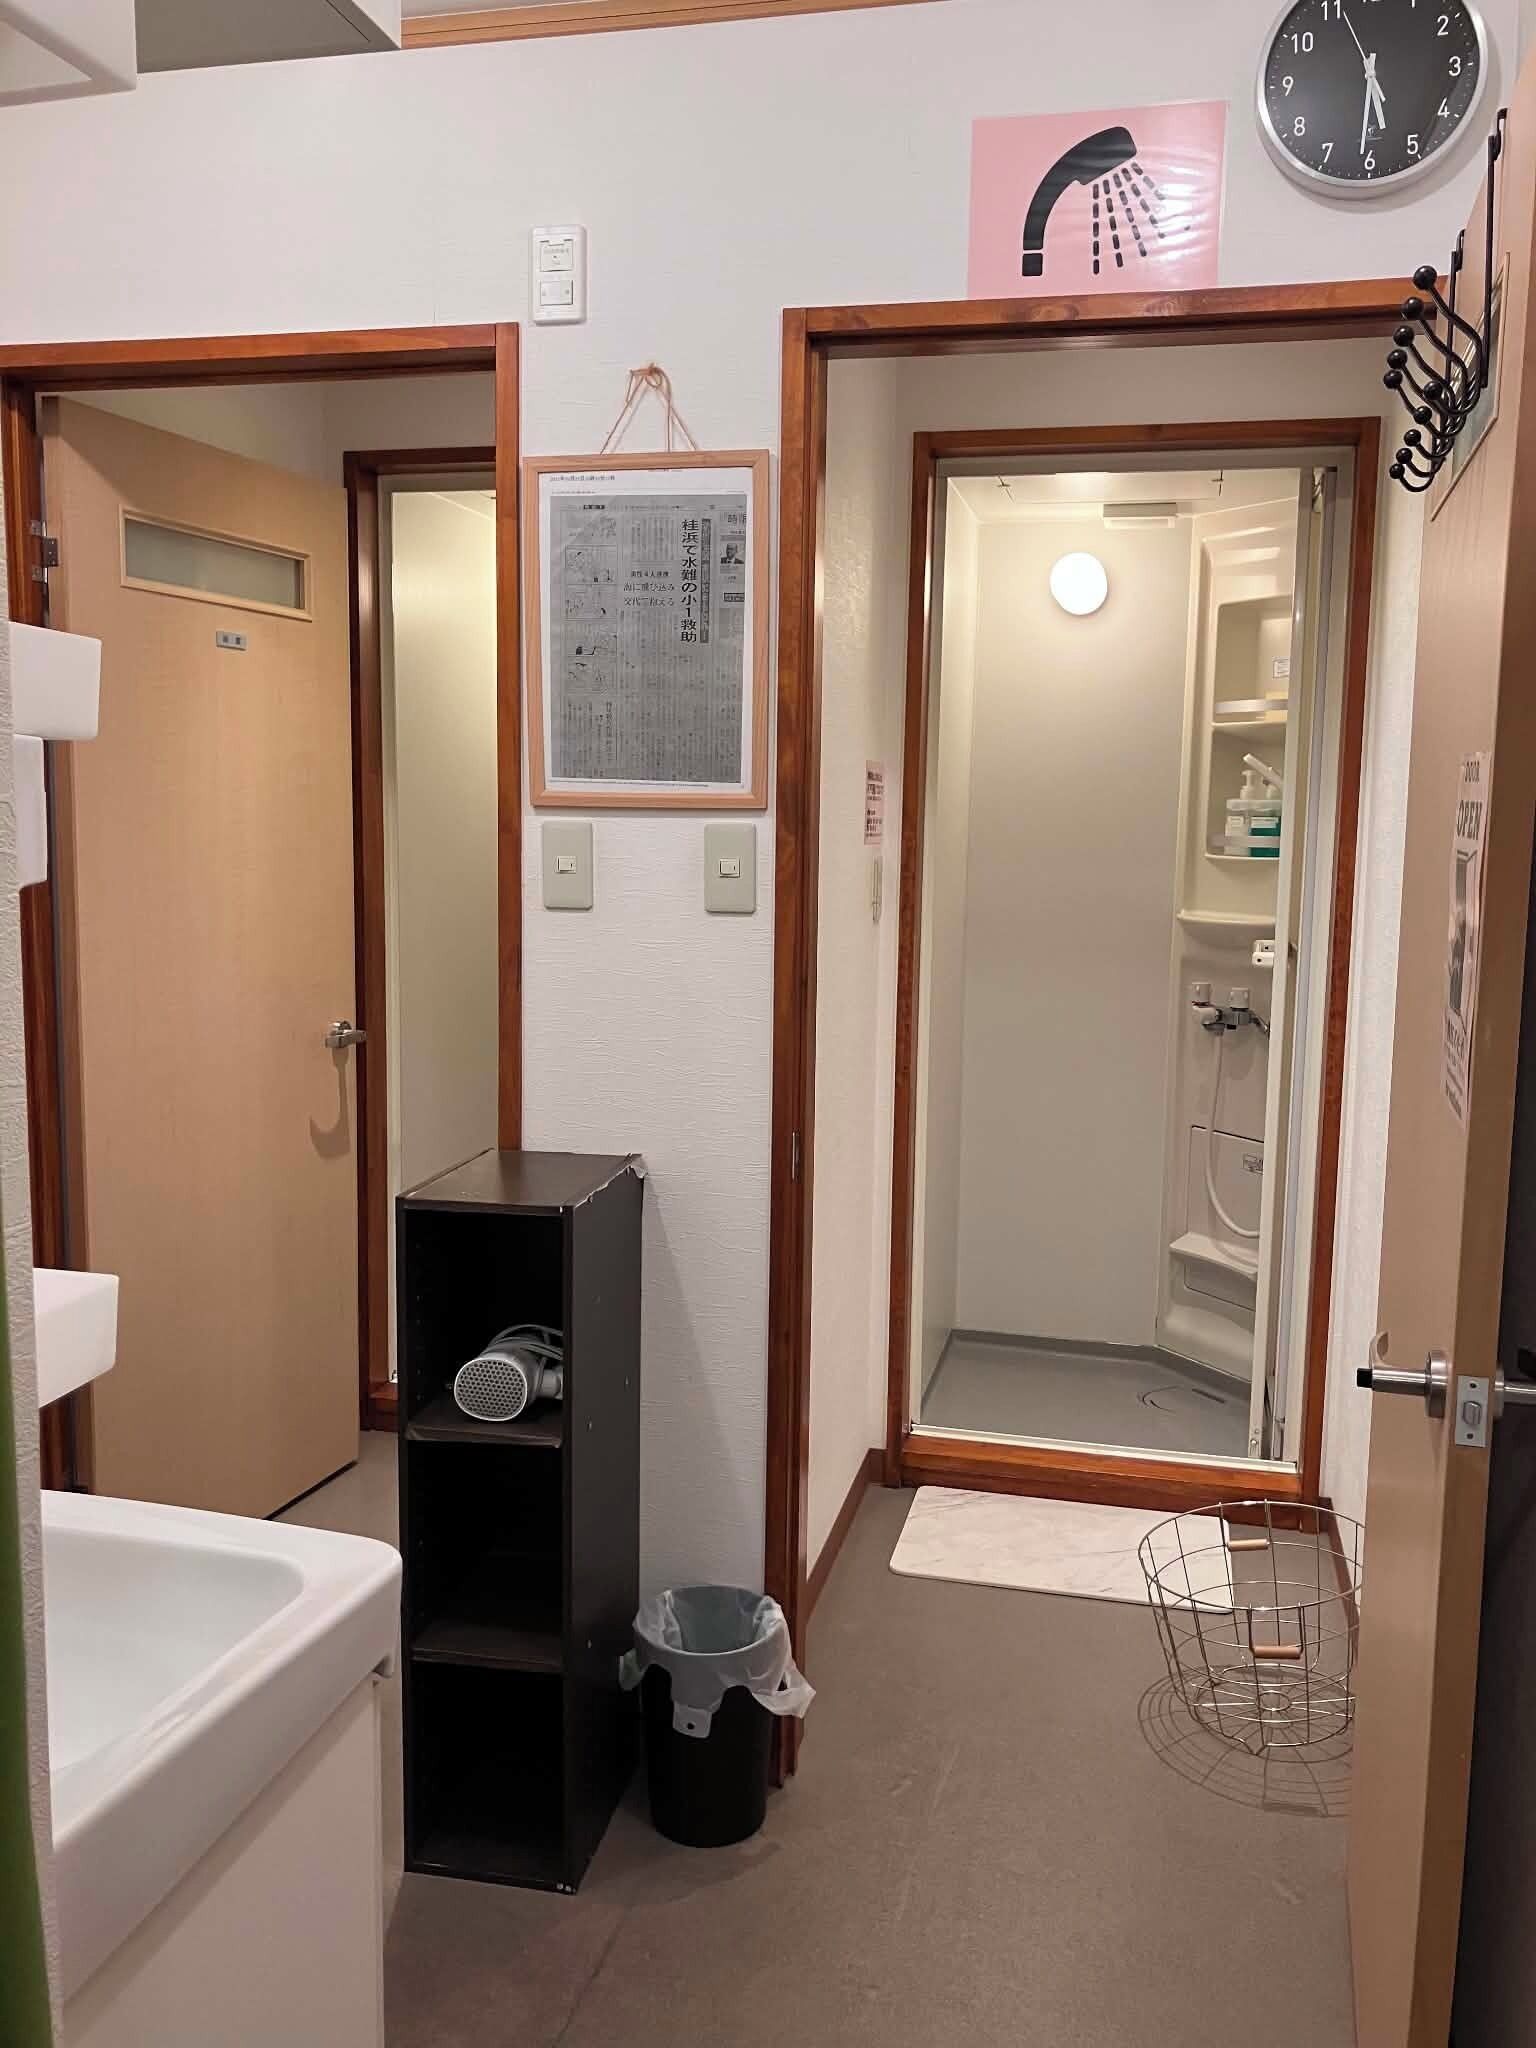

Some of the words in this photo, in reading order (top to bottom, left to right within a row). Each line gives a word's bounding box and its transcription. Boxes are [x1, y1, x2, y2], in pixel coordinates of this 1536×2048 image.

[1321, 0, 1341, 20] 11
[1437, 15, 1449, 36] 2
[1291, 32, 1314, 54] 10
[1448, 56, 1461, 77] 3
[1282, 76, 1293, 97] 9
[1437, 97, 1450, 118] 4
[1294, 117, 1305, 137] 8
[1322, 143, 1333, 163] 7
[1407, 134, 1418, 155] 5
[1364, 150, 1375, 170] 6
[1456, 799, 1482, 840] OPEN
